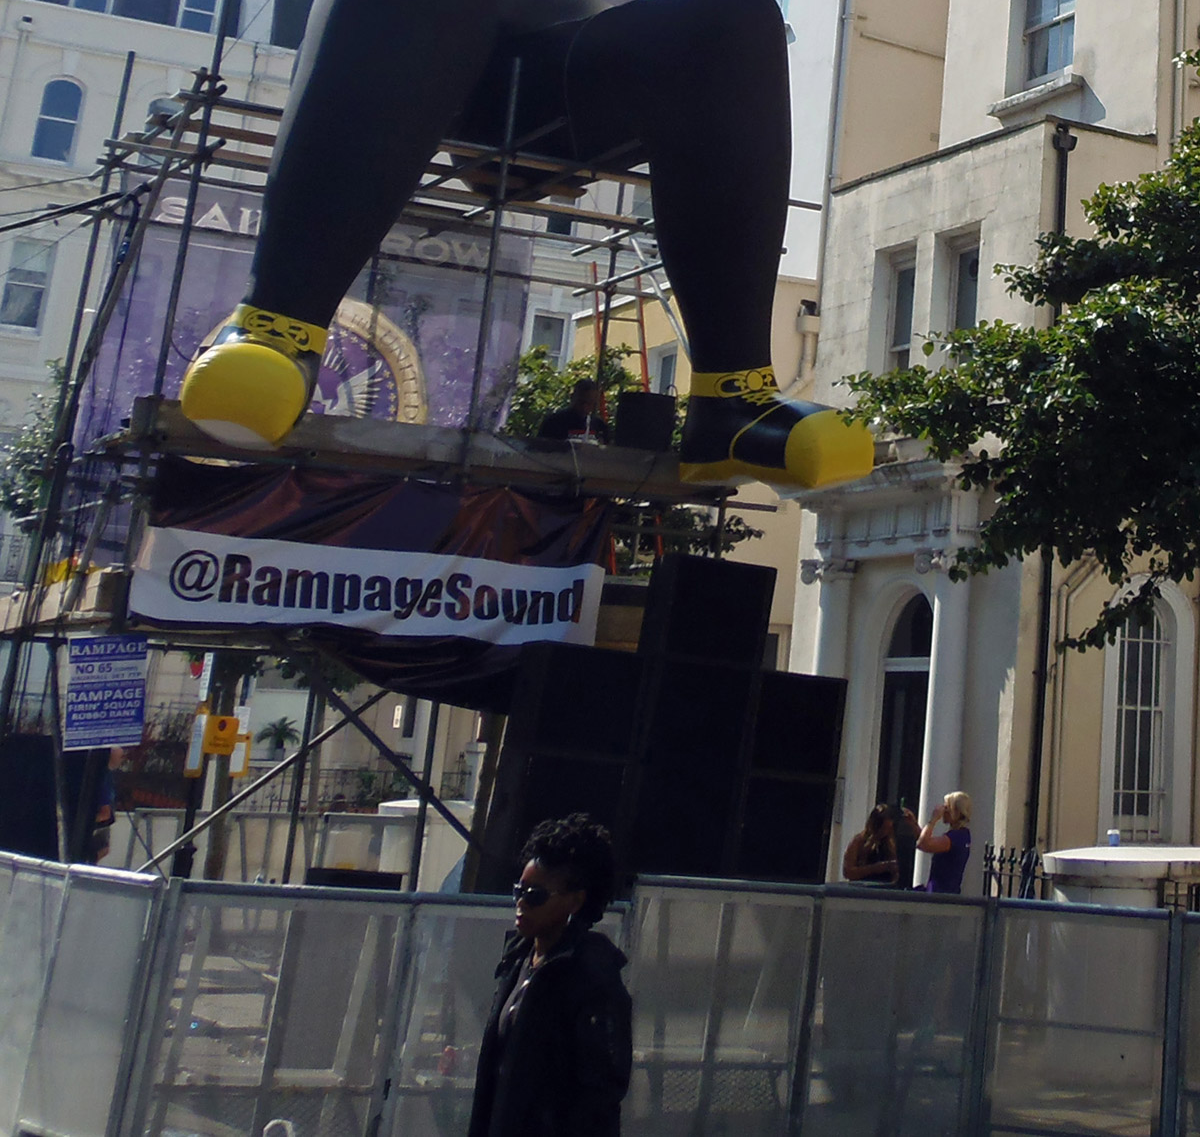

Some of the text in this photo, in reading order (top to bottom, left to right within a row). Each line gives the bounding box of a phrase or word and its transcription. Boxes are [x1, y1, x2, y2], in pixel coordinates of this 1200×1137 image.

[169, 549, 586, 625] @RampageSound
[71, 641, 147, 656] RAMPAGE
[75, 663, 95, 675] NO
[68, 687, 143, 703] RAMPAGE
[103, 699, 141, 710] SQUAD
